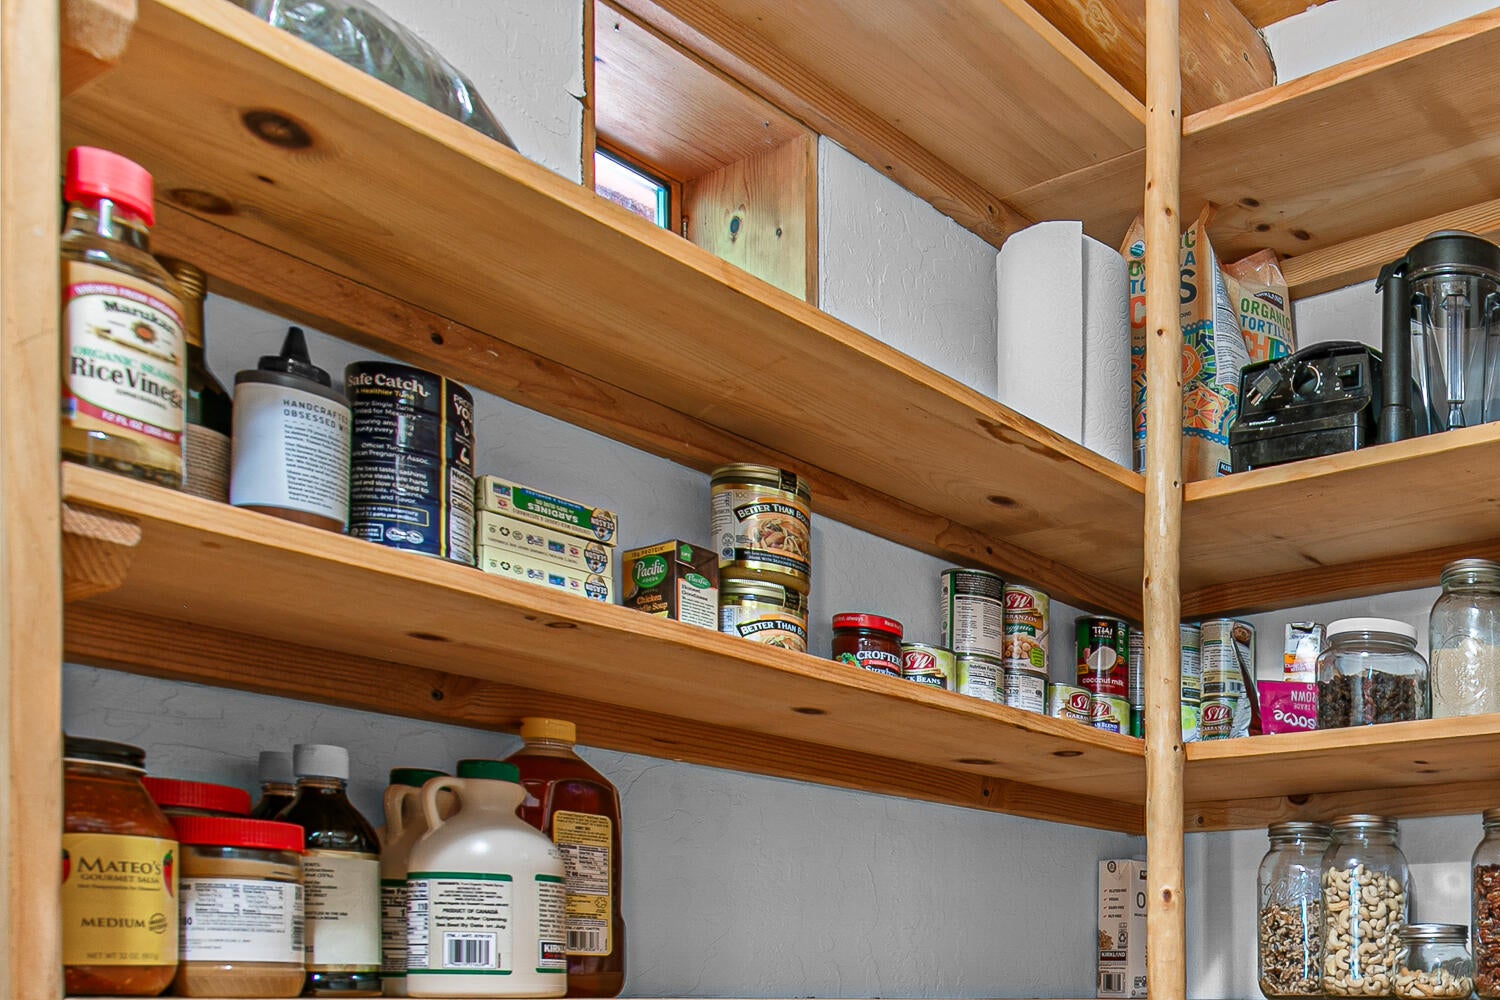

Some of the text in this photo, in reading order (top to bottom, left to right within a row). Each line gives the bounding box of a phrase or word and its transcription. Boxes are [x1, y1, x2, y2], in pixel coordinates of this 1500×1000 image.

[1240, 298, 1291, 331] ORGANIC
[348, 373, 431, 397] Safe Catch
[283, 408, 336, 428] OBSESSED
[527, 502, 578, 523] SARDINES
[737, 503, 795, 519] BETTER THAN
[635, 559, 665, 580] Pacific
[740, 621, 797, 637] BETTER THAN
[1092, 626, 1113, 635] THAI
[917, 675, 941, 685] BEANS
[1082, 676, 1124, 686] coconut milk
[77, 857, 161, 875] MATEO'S
[80, 873, 135, 883] GOURMET
[80, 917, 145, 929] MEDIUM
